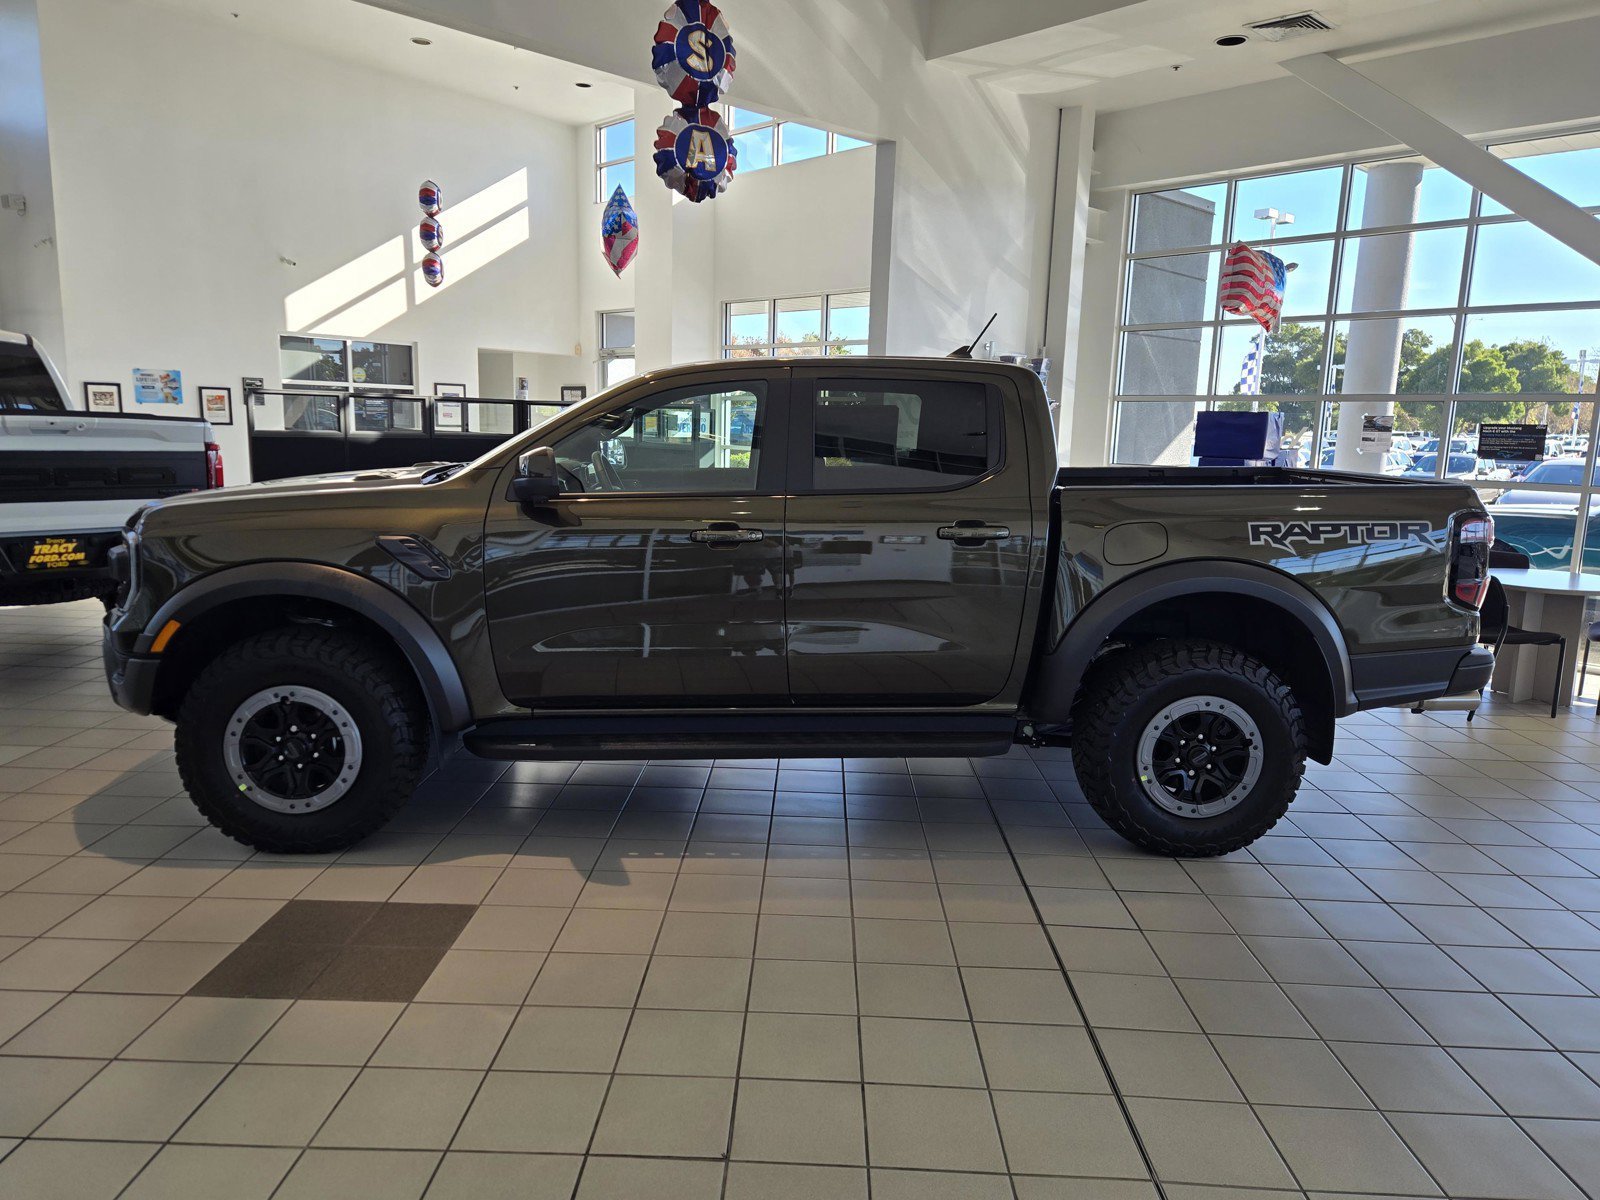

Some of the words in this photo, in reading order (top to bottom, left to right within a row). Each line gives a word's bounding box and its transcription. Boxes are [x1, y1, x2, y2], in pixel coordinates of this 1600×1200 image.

[686, 29, 716, 73] S
[685, 129, 717, 172] A
[33, 543, 78, 555] TRACY
[1247, 519, 1442, 556] RAPTOR
[28, 552, 86, 564] FORD.COM
